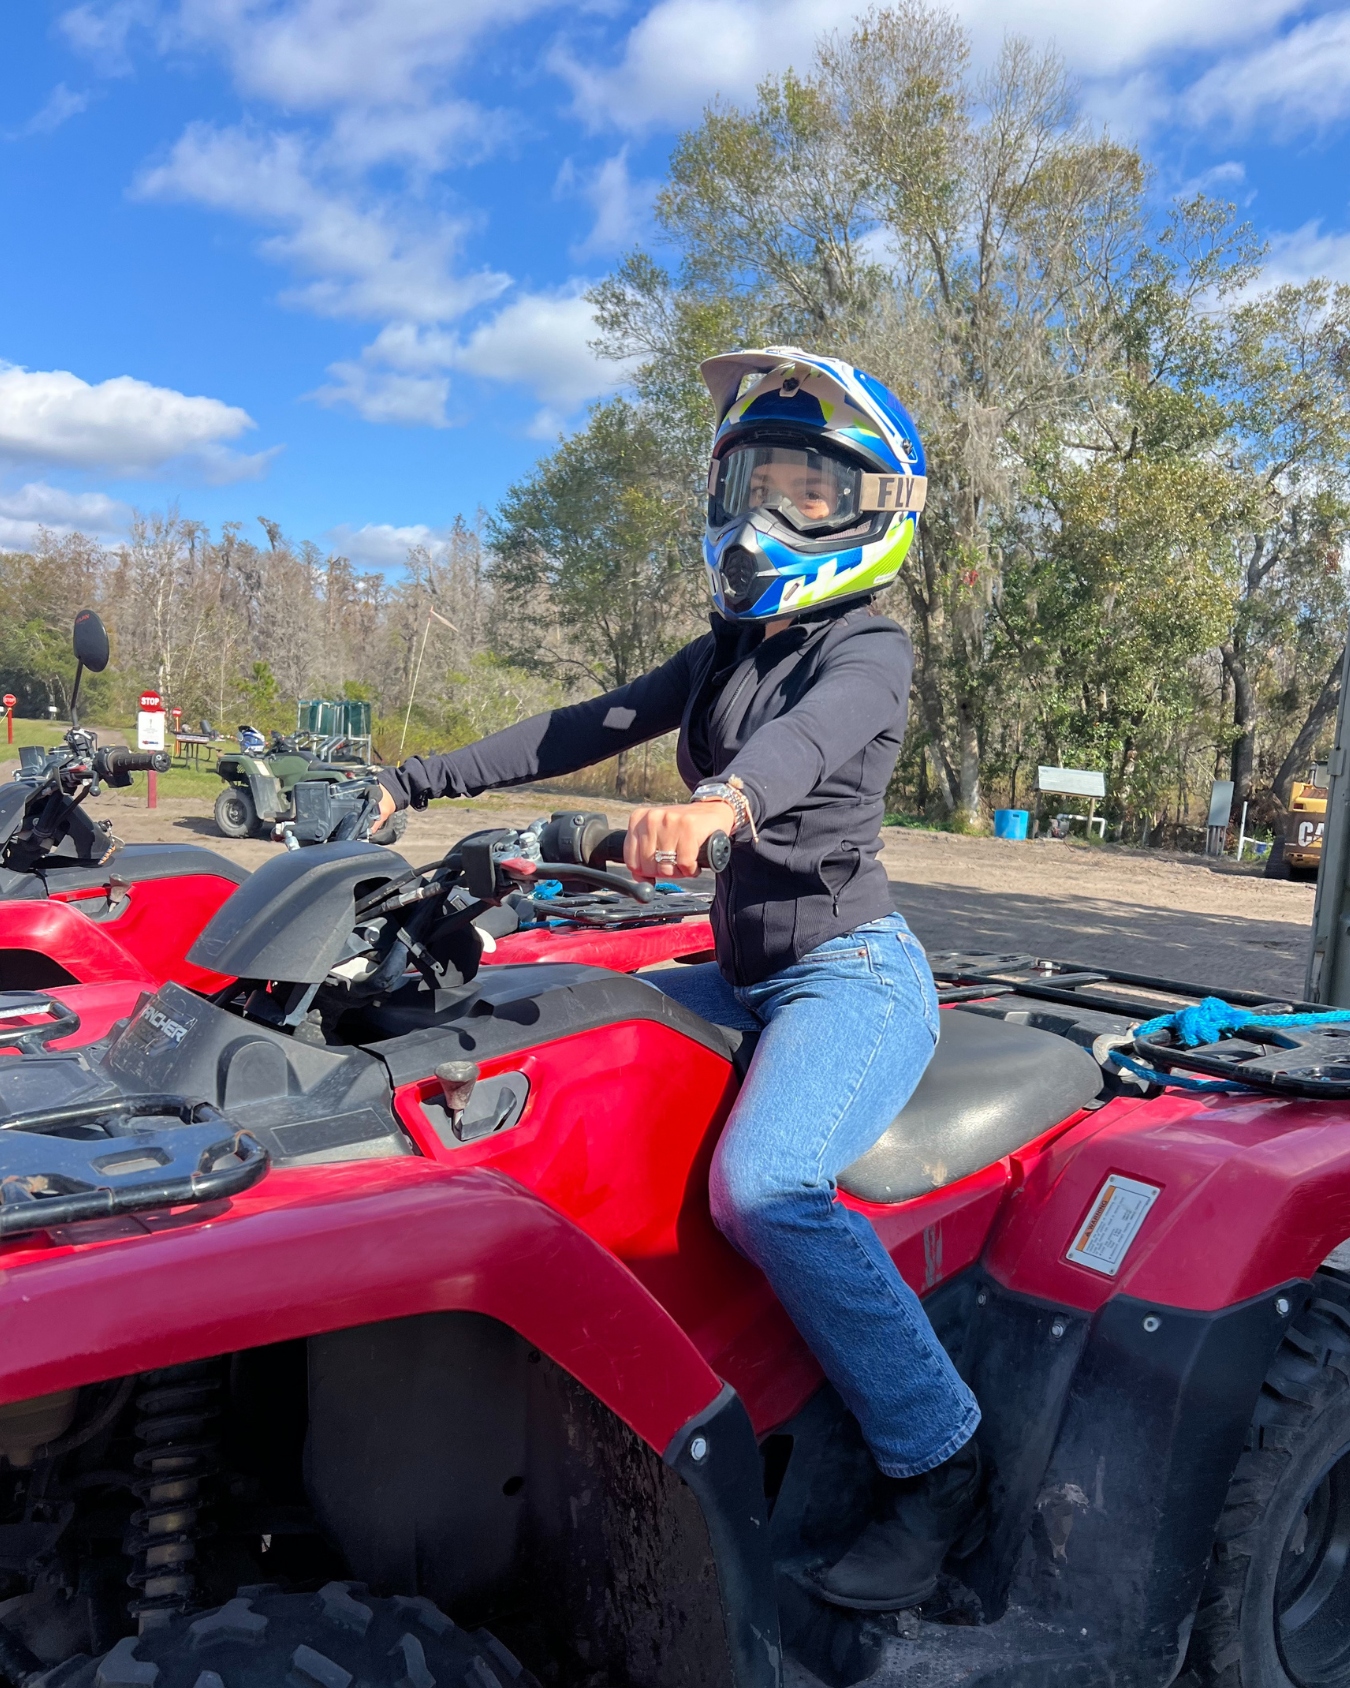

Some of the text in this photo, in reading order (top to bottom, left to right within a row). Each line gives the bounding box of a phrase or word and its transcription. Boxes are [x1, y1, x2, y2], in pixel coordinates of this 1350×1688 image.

[877, 477, 915, 508] FLY
[140, 697, 160, 706] STOP
[1298, 821, 1325, 847] CA
[142, 1006, 189, 1043] ANCHER
